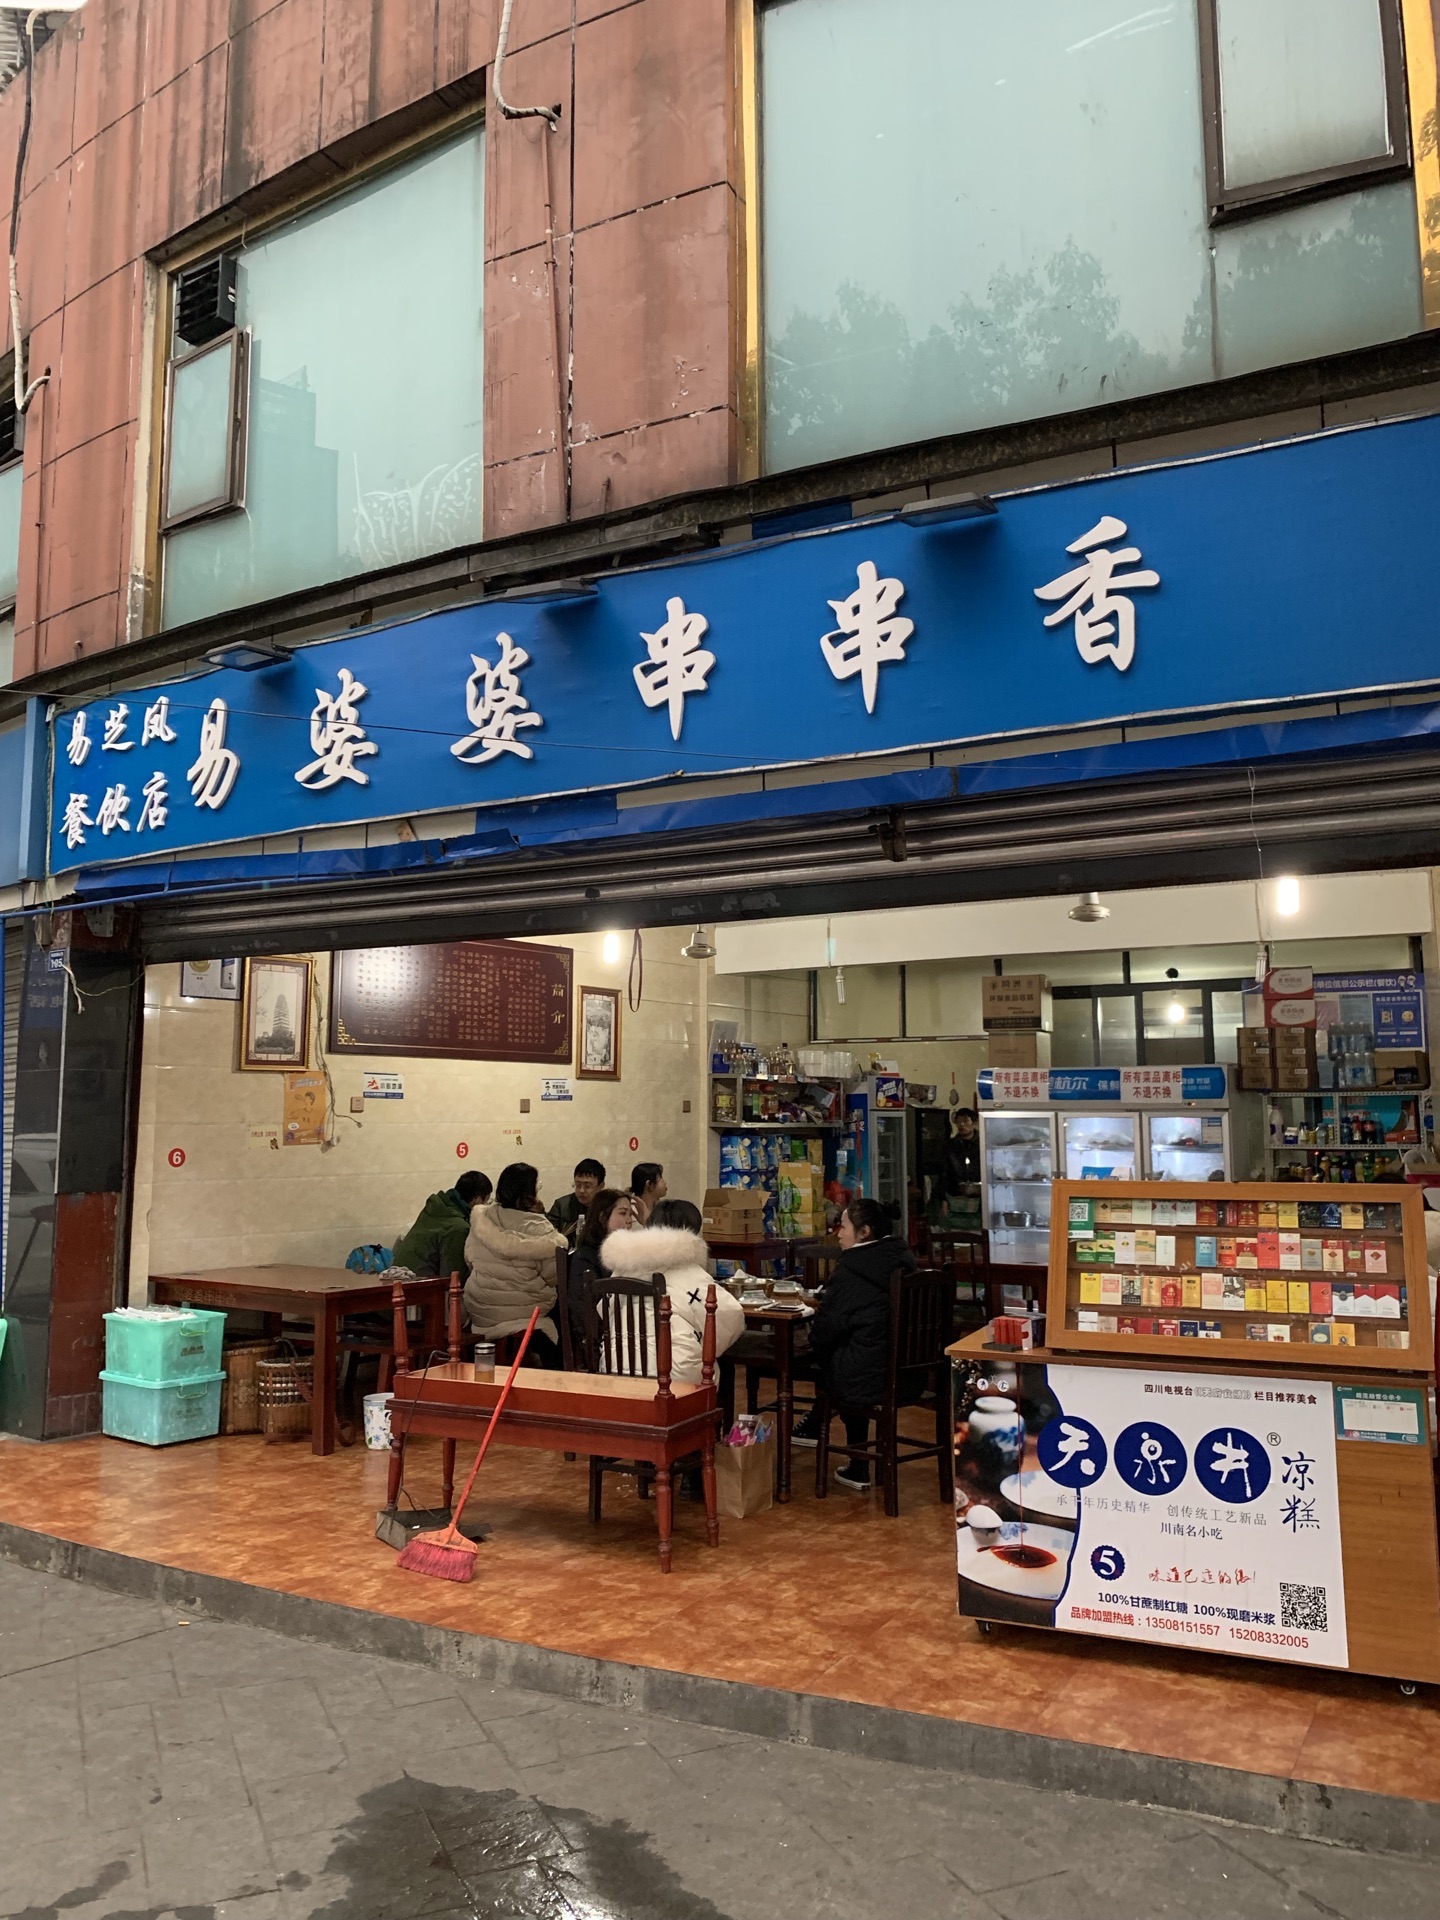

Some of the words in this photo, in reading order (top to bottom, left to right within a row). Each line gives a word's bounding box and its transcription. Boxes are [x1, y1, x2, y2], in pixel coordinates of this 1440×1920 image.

[186, 515, 1161, 811] 易婆婆串串香
[59, 771, 169, 849] 餐饮店
[995, 1071, 1048, 1083] 所有菜品离柜
[1123, 1070, 1181, 1083] 所有菜品离柜
[1003, 1086, 1039, 1098] 不退不换
[1132, 1086, 1172, 1098] 不退不换
[1279, 1451, 1321, 1533] 凉糕
[1166, 1504, 1267, 1526] 创传统工艺新品
[1160, 1522, 1223, 1540] 川南名小吃
[1097, 1592, 1188, 1615] 100%甘蔗制红糖
[1193, 1604, 1276, 1626] 100%现磨米浆
[1229, 1627, 1309, 1649] 15208332005
